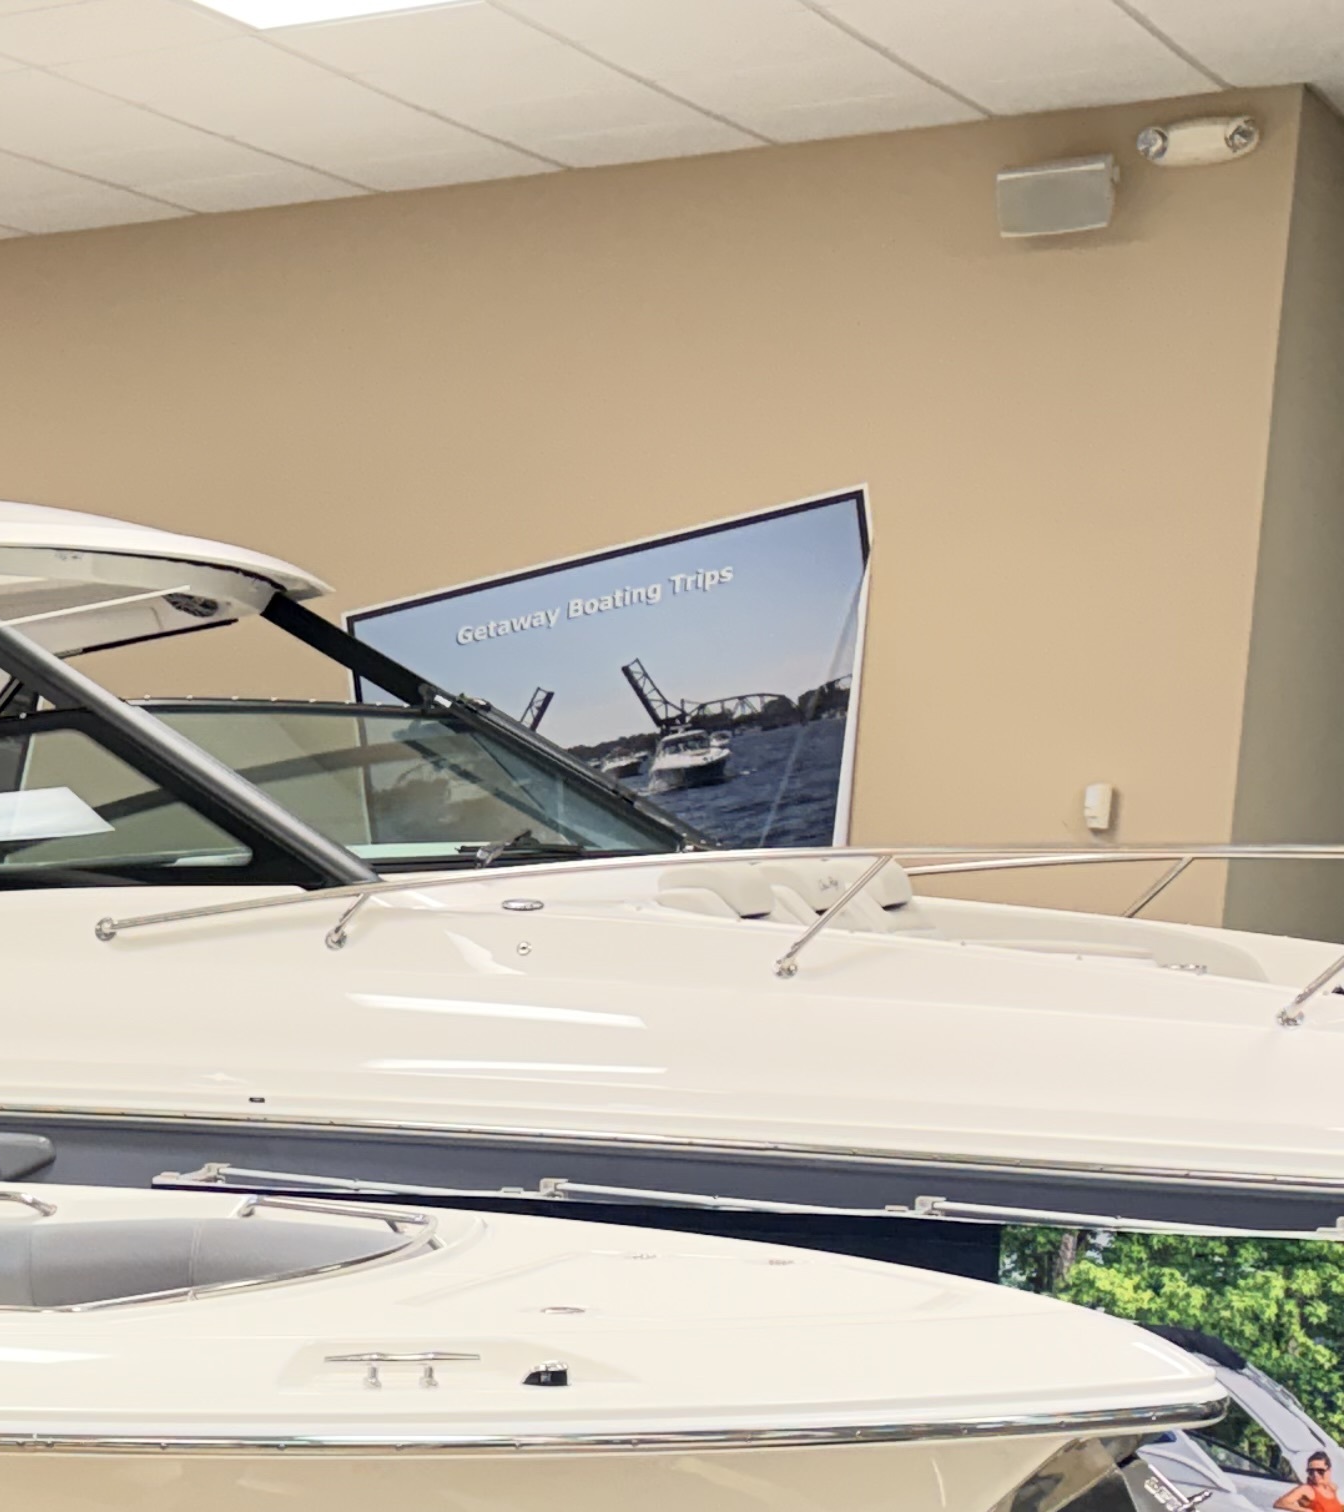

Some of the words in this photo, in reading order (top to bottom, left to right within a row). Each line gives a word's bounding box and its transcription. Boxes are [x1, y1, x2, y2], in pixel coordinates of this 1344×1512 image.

[456, 605, 561, 645] Getaway
[567, 583, 662, 619] Boating
[668, 566, 734, 594] Trips
